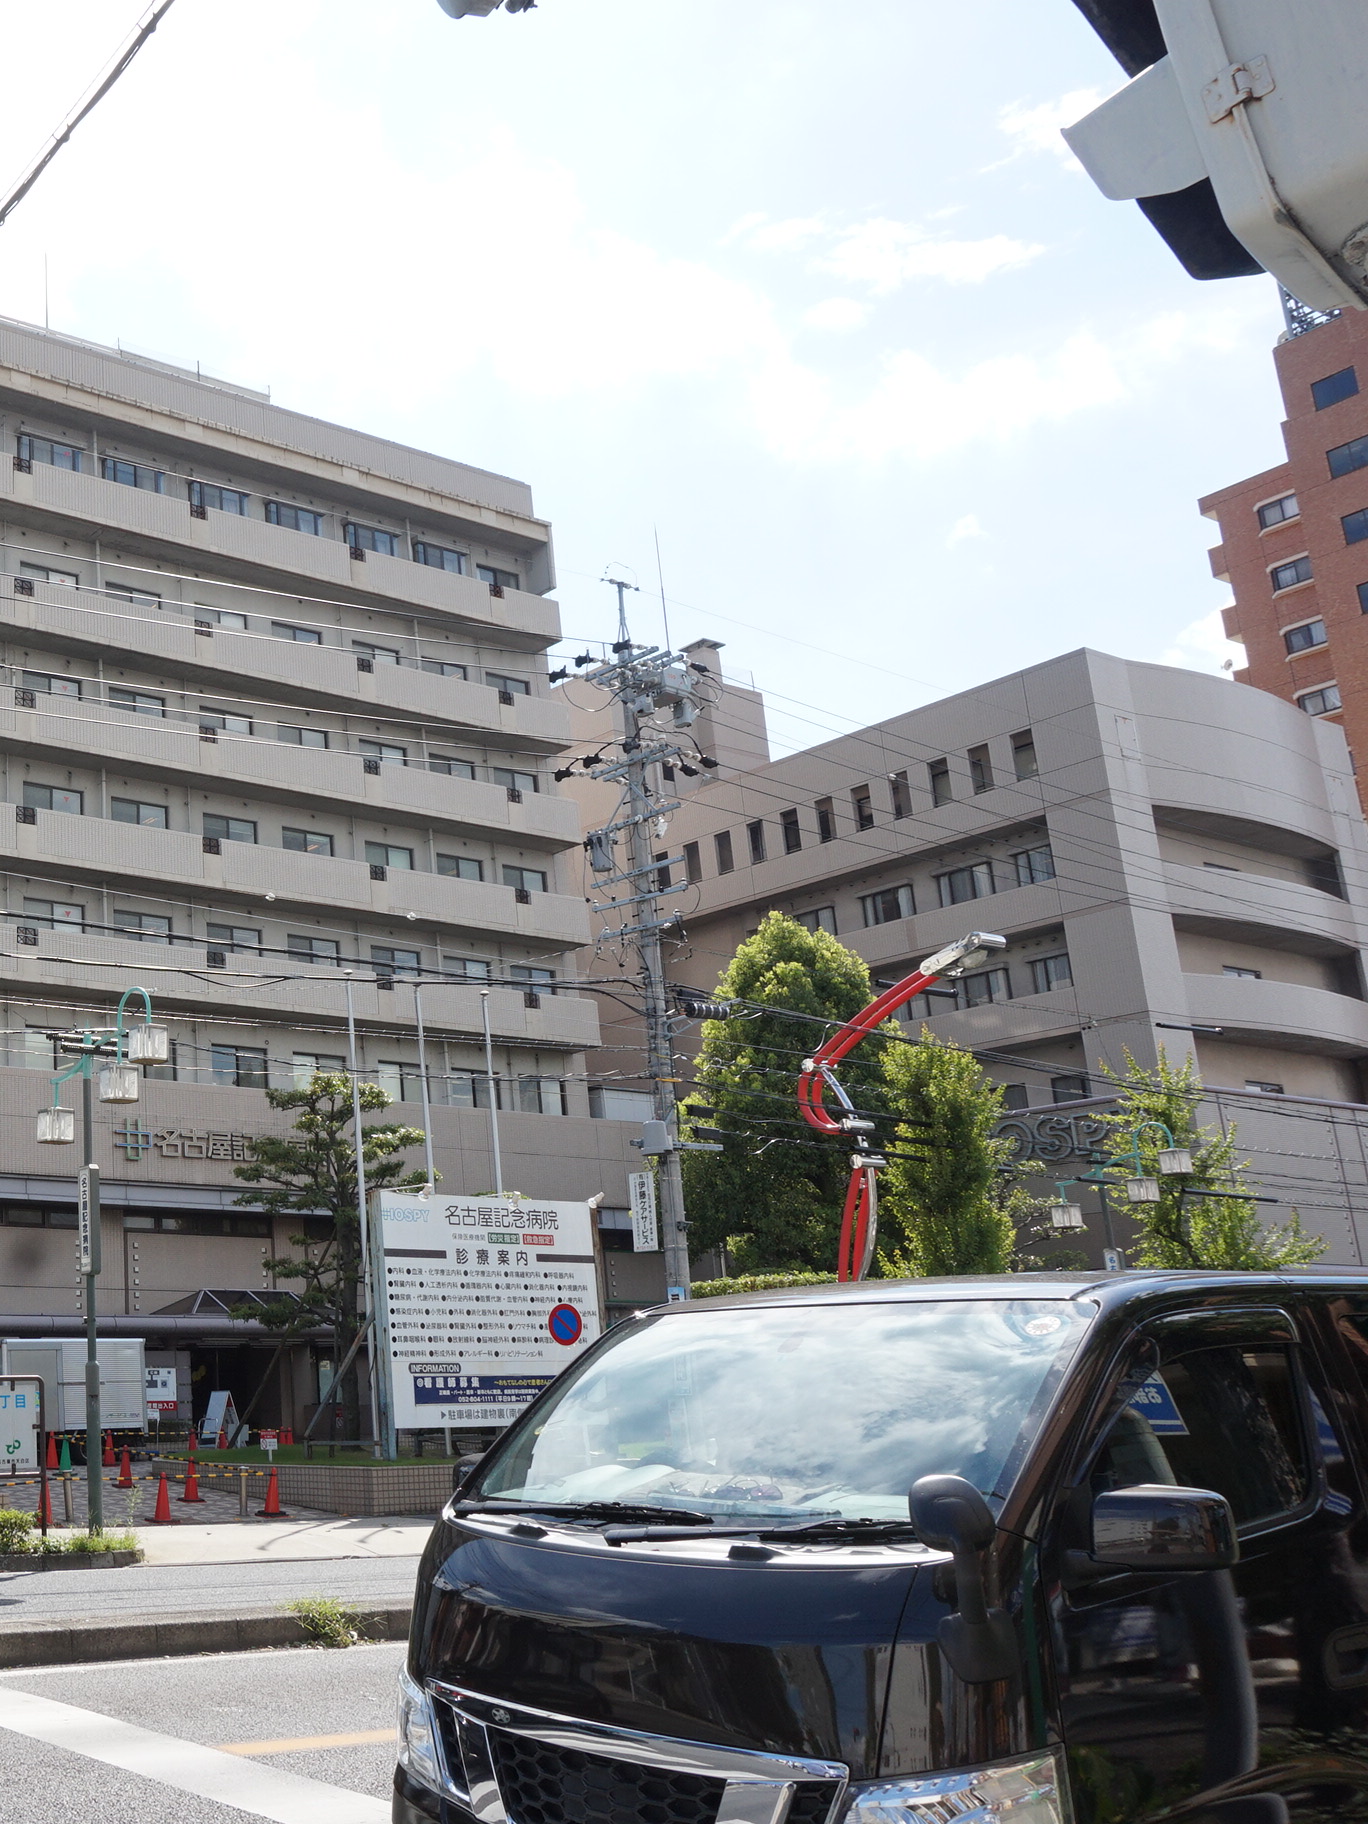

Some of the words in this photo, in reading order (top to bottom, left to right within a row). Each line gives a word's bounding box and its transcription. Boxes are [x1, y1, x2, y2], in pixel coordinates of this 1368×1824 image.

[445, 1205, 559, 1230] 名古屋記念病院
[452, 1233, 486, 1242] 保険医療機関
[456, 1248, 528, 1266] 診療案内
[411, 1364, 460, 1372] INFORMATION
[424, 1377, 480, 1388] 看護師募集
